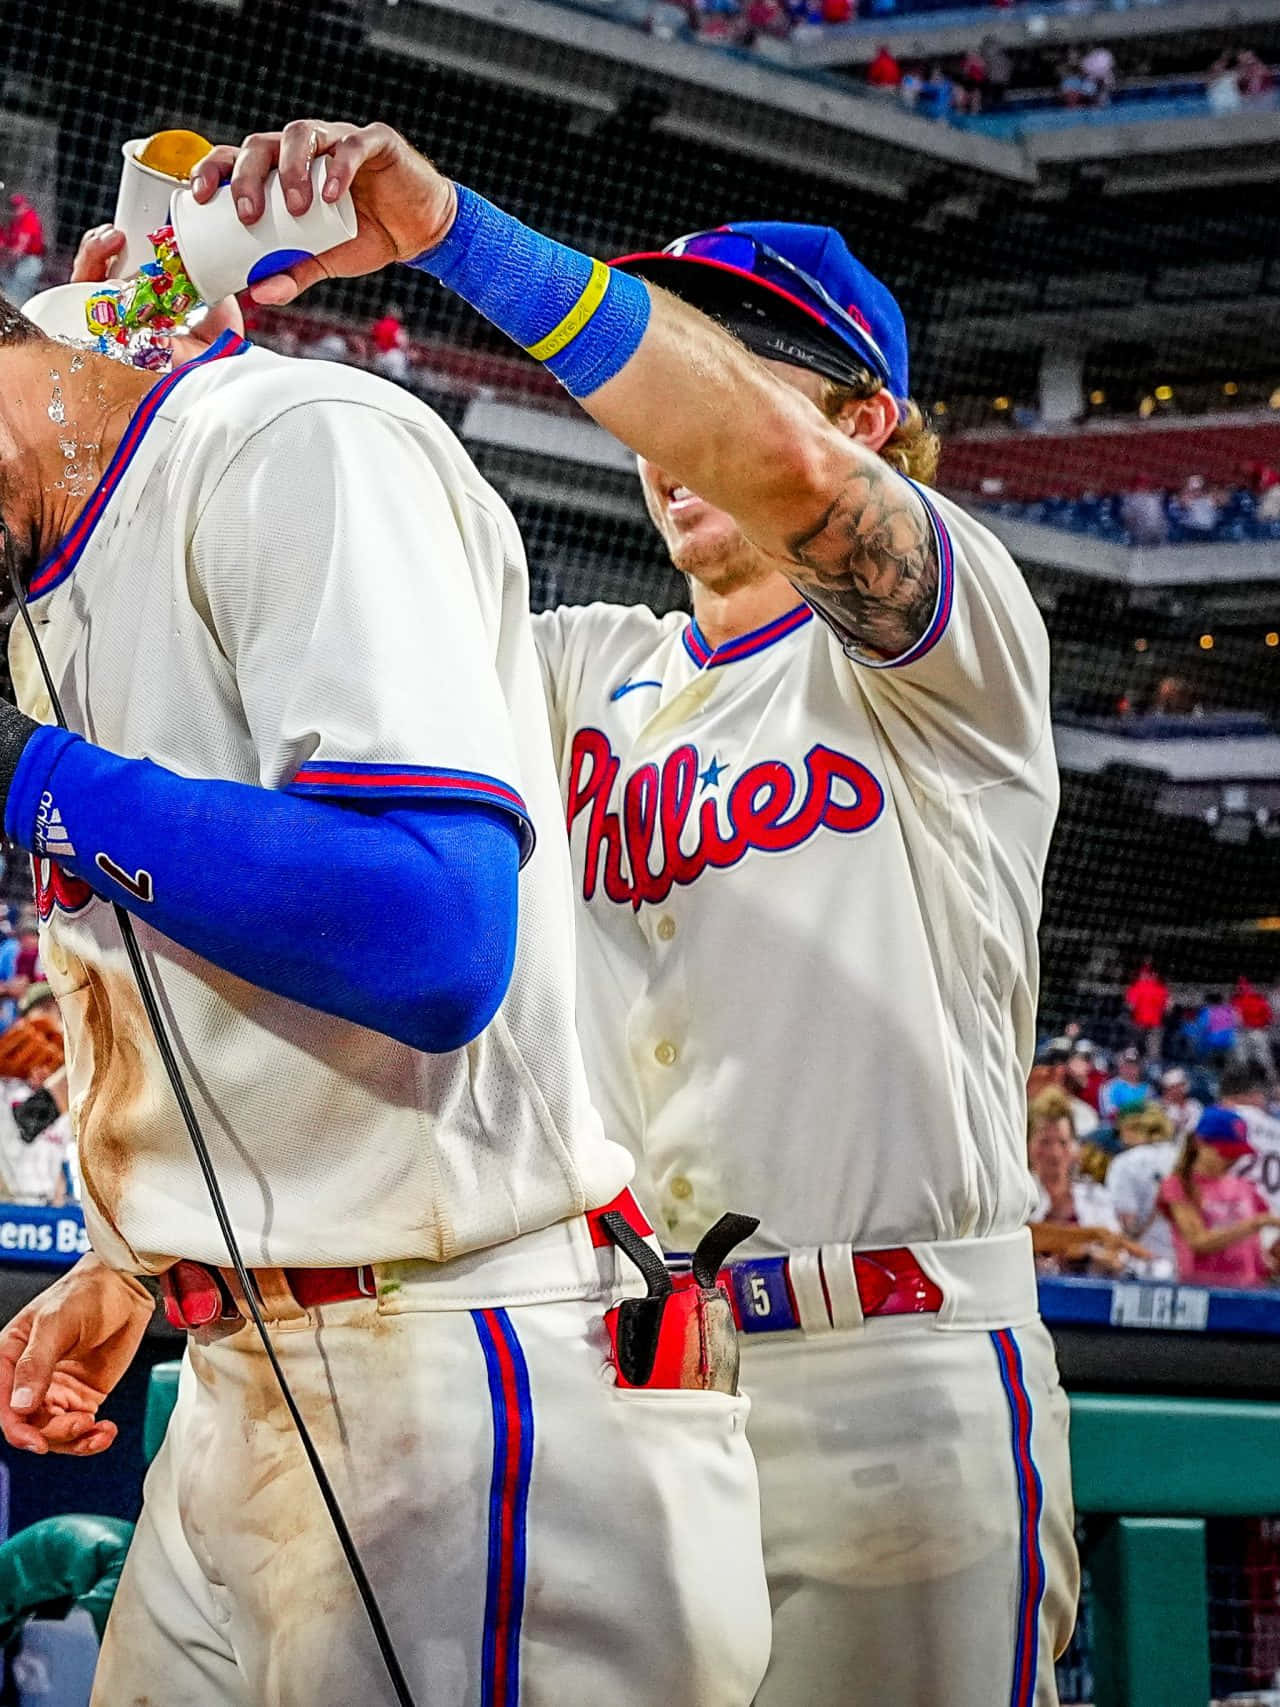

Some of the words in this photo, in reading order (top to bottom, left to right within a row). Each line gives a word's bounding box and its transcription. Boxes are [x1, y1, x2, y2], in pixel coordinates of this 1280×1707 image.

[567, 727, 885, 912] Phllies
[56, 1218, 91, 1253] Ba
[751, 1277, 771, 1317] 5
